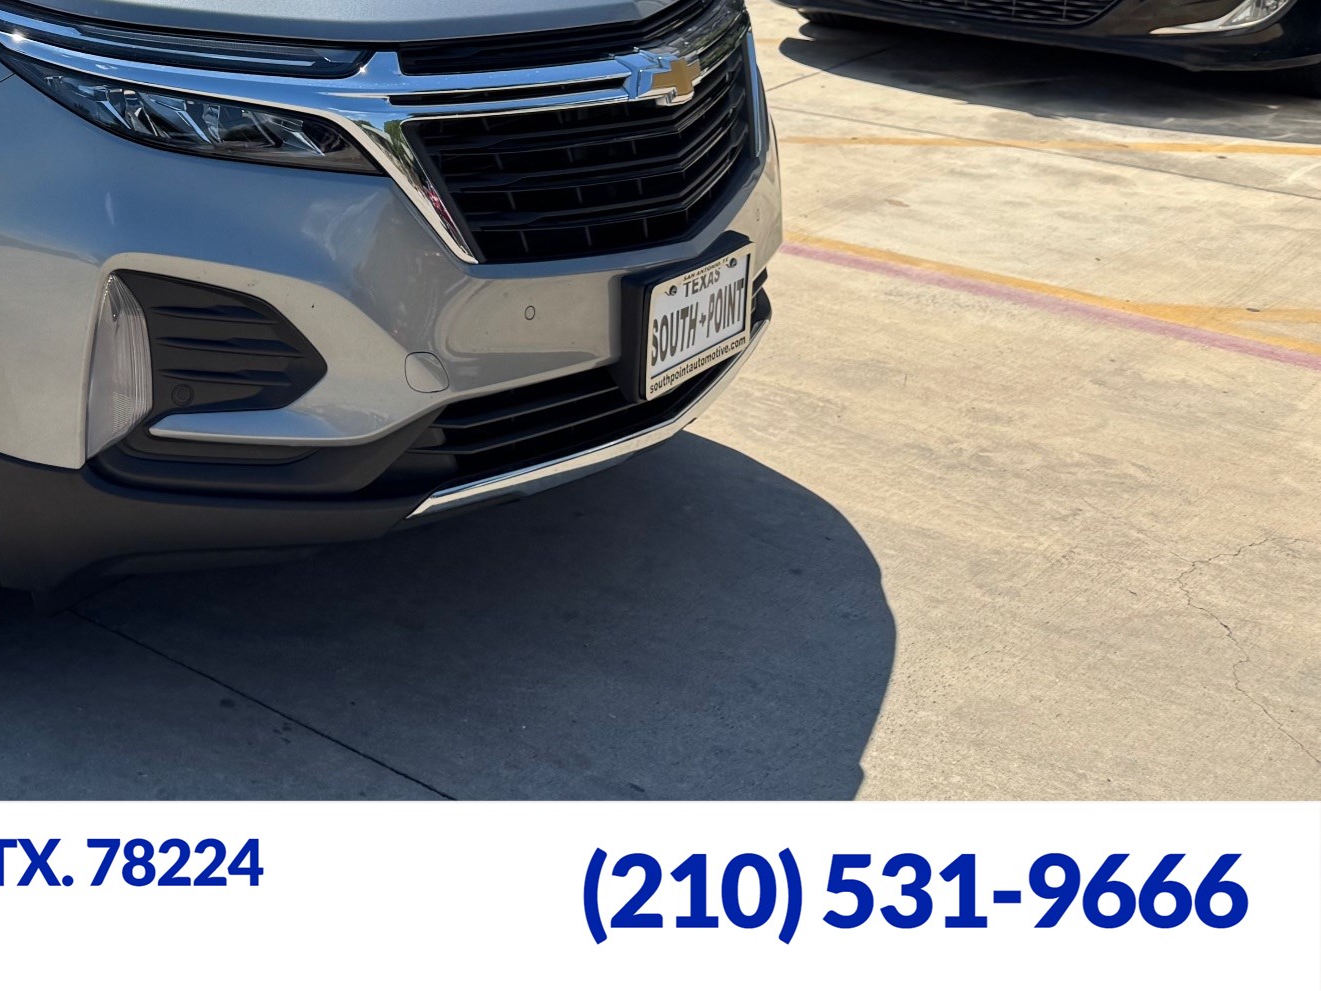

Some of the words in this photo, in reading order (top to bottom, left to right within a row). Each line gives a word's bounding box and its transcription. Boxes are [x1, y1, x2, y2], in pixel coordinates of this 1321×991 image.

[682, 268, 722, 298] TEXAS
[651, 301, 699, 367] SOUTH
[706, 277, 745, 339] POINT
[649, 336, 747, 395] southpointautomotive.com
